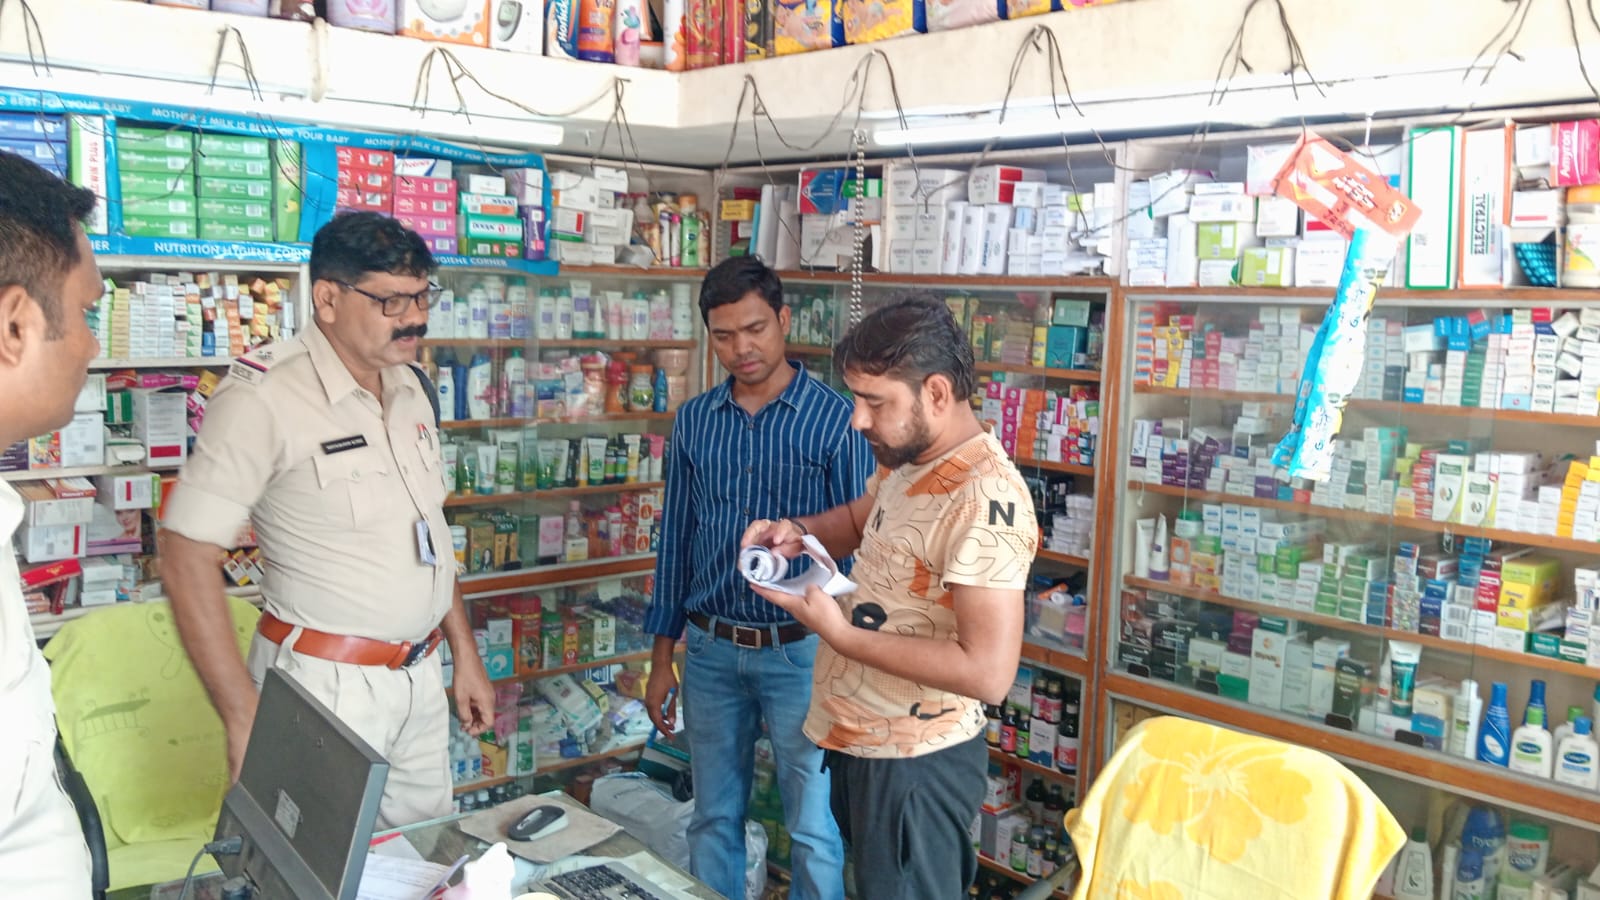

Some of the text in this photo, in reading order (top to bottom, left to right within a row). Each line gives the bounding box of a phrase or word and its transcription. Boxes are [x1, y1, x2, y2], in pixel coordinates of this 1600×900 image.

[209, 117, 235, 130] MILK
[236, 121, 246, 130] IS
[296, 128, 323, 141] YOUR
[326, 132, 350, 145] BABY
[1474, 192, 1486, 256] ELECTRAL
[154, 241, 219, 256] NUTRITION
[470, 257, 508, 267] CORNER
[989, 500, 1015, 527] N
